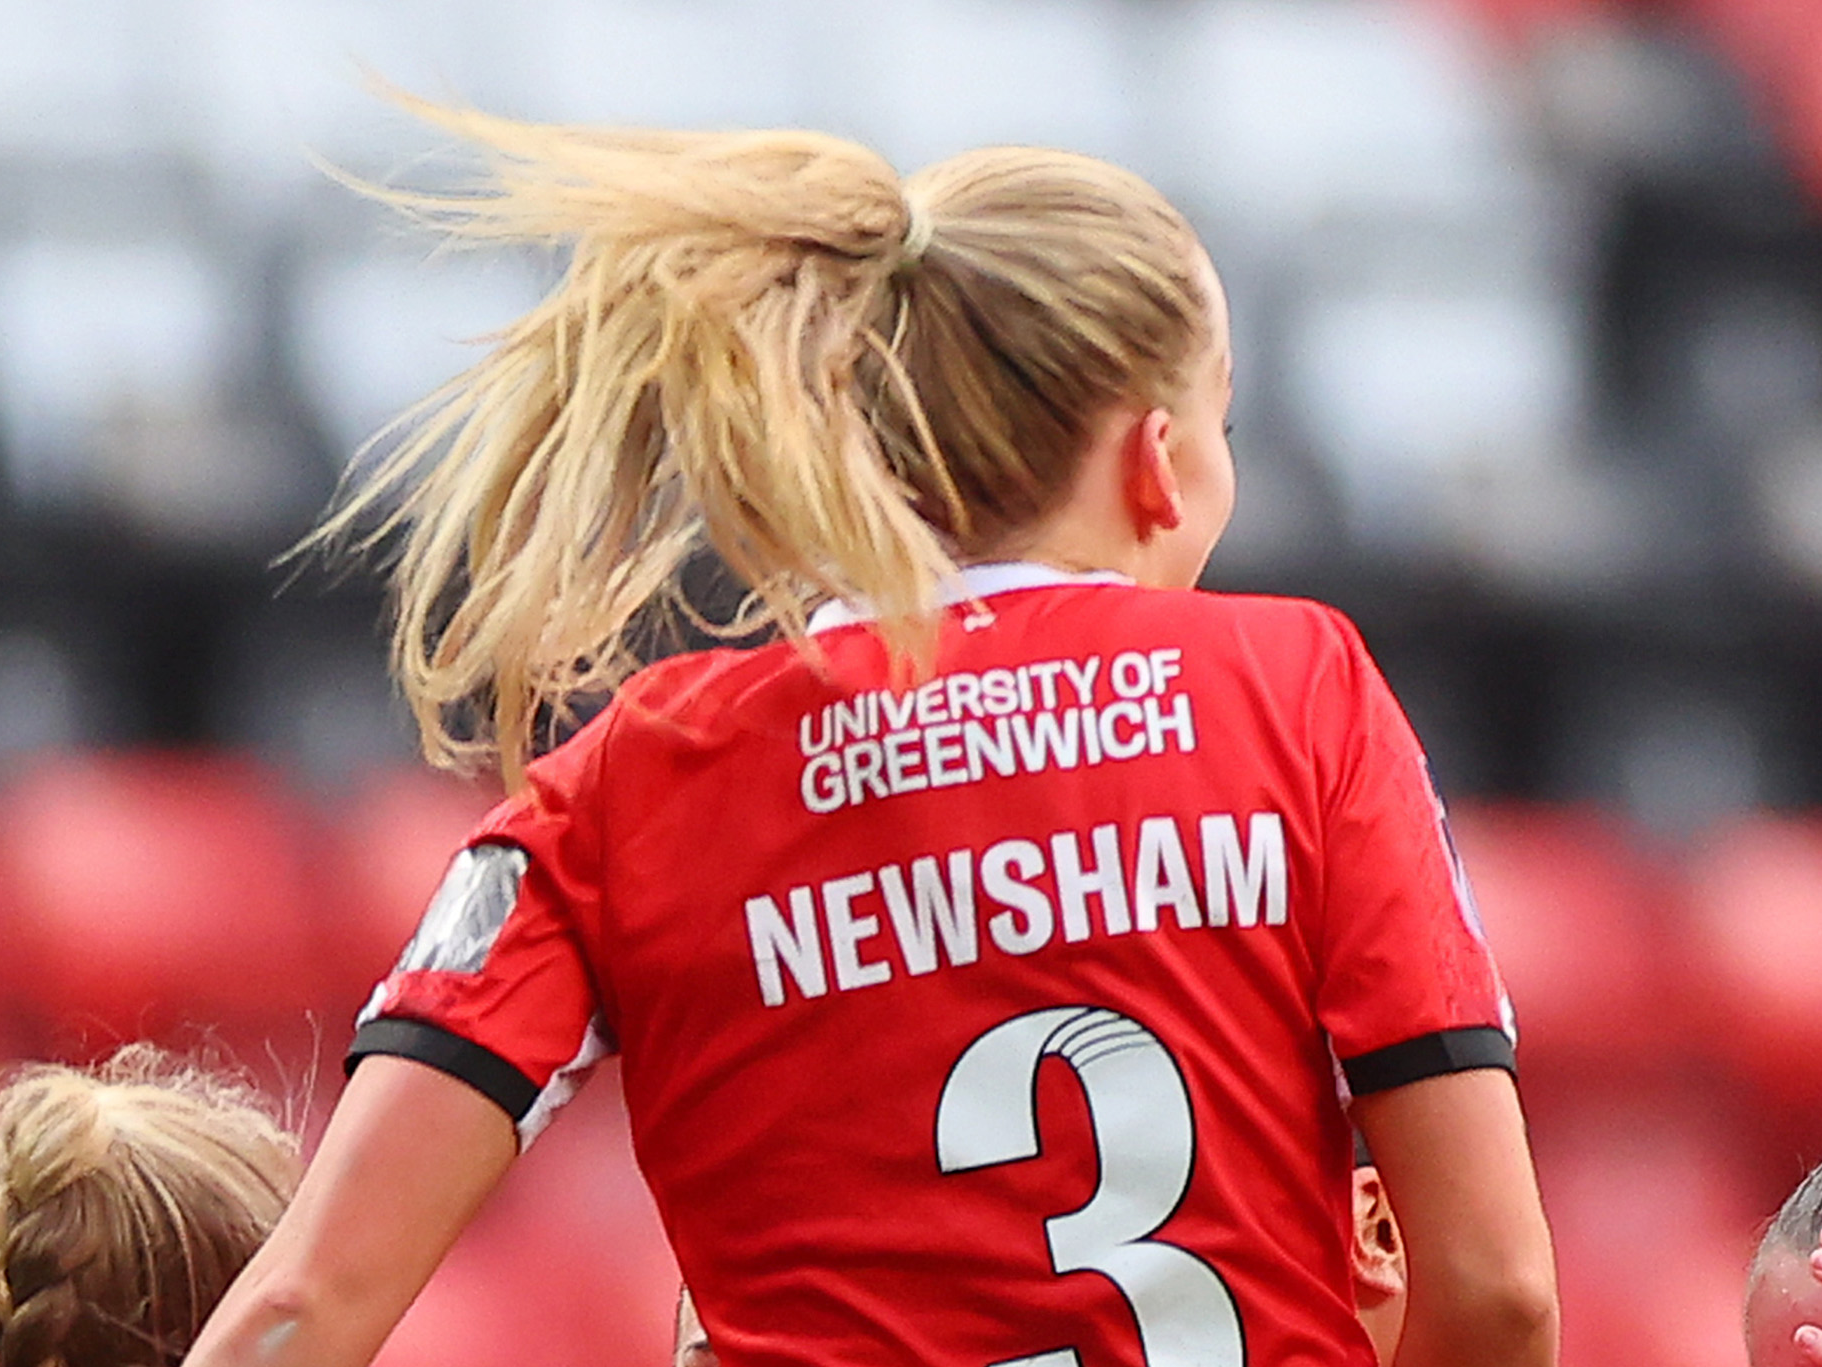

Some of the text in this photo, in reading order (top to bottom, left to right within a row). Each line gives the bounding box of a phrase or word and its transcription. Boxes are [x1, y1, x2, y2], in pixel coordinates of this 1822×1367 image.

[799, 648, 1182, 758] UNIVERSITY OF
[799, 693, 1197, 815] GREENWICH
[744, 812, 1288, 1006] NEWSHAM
